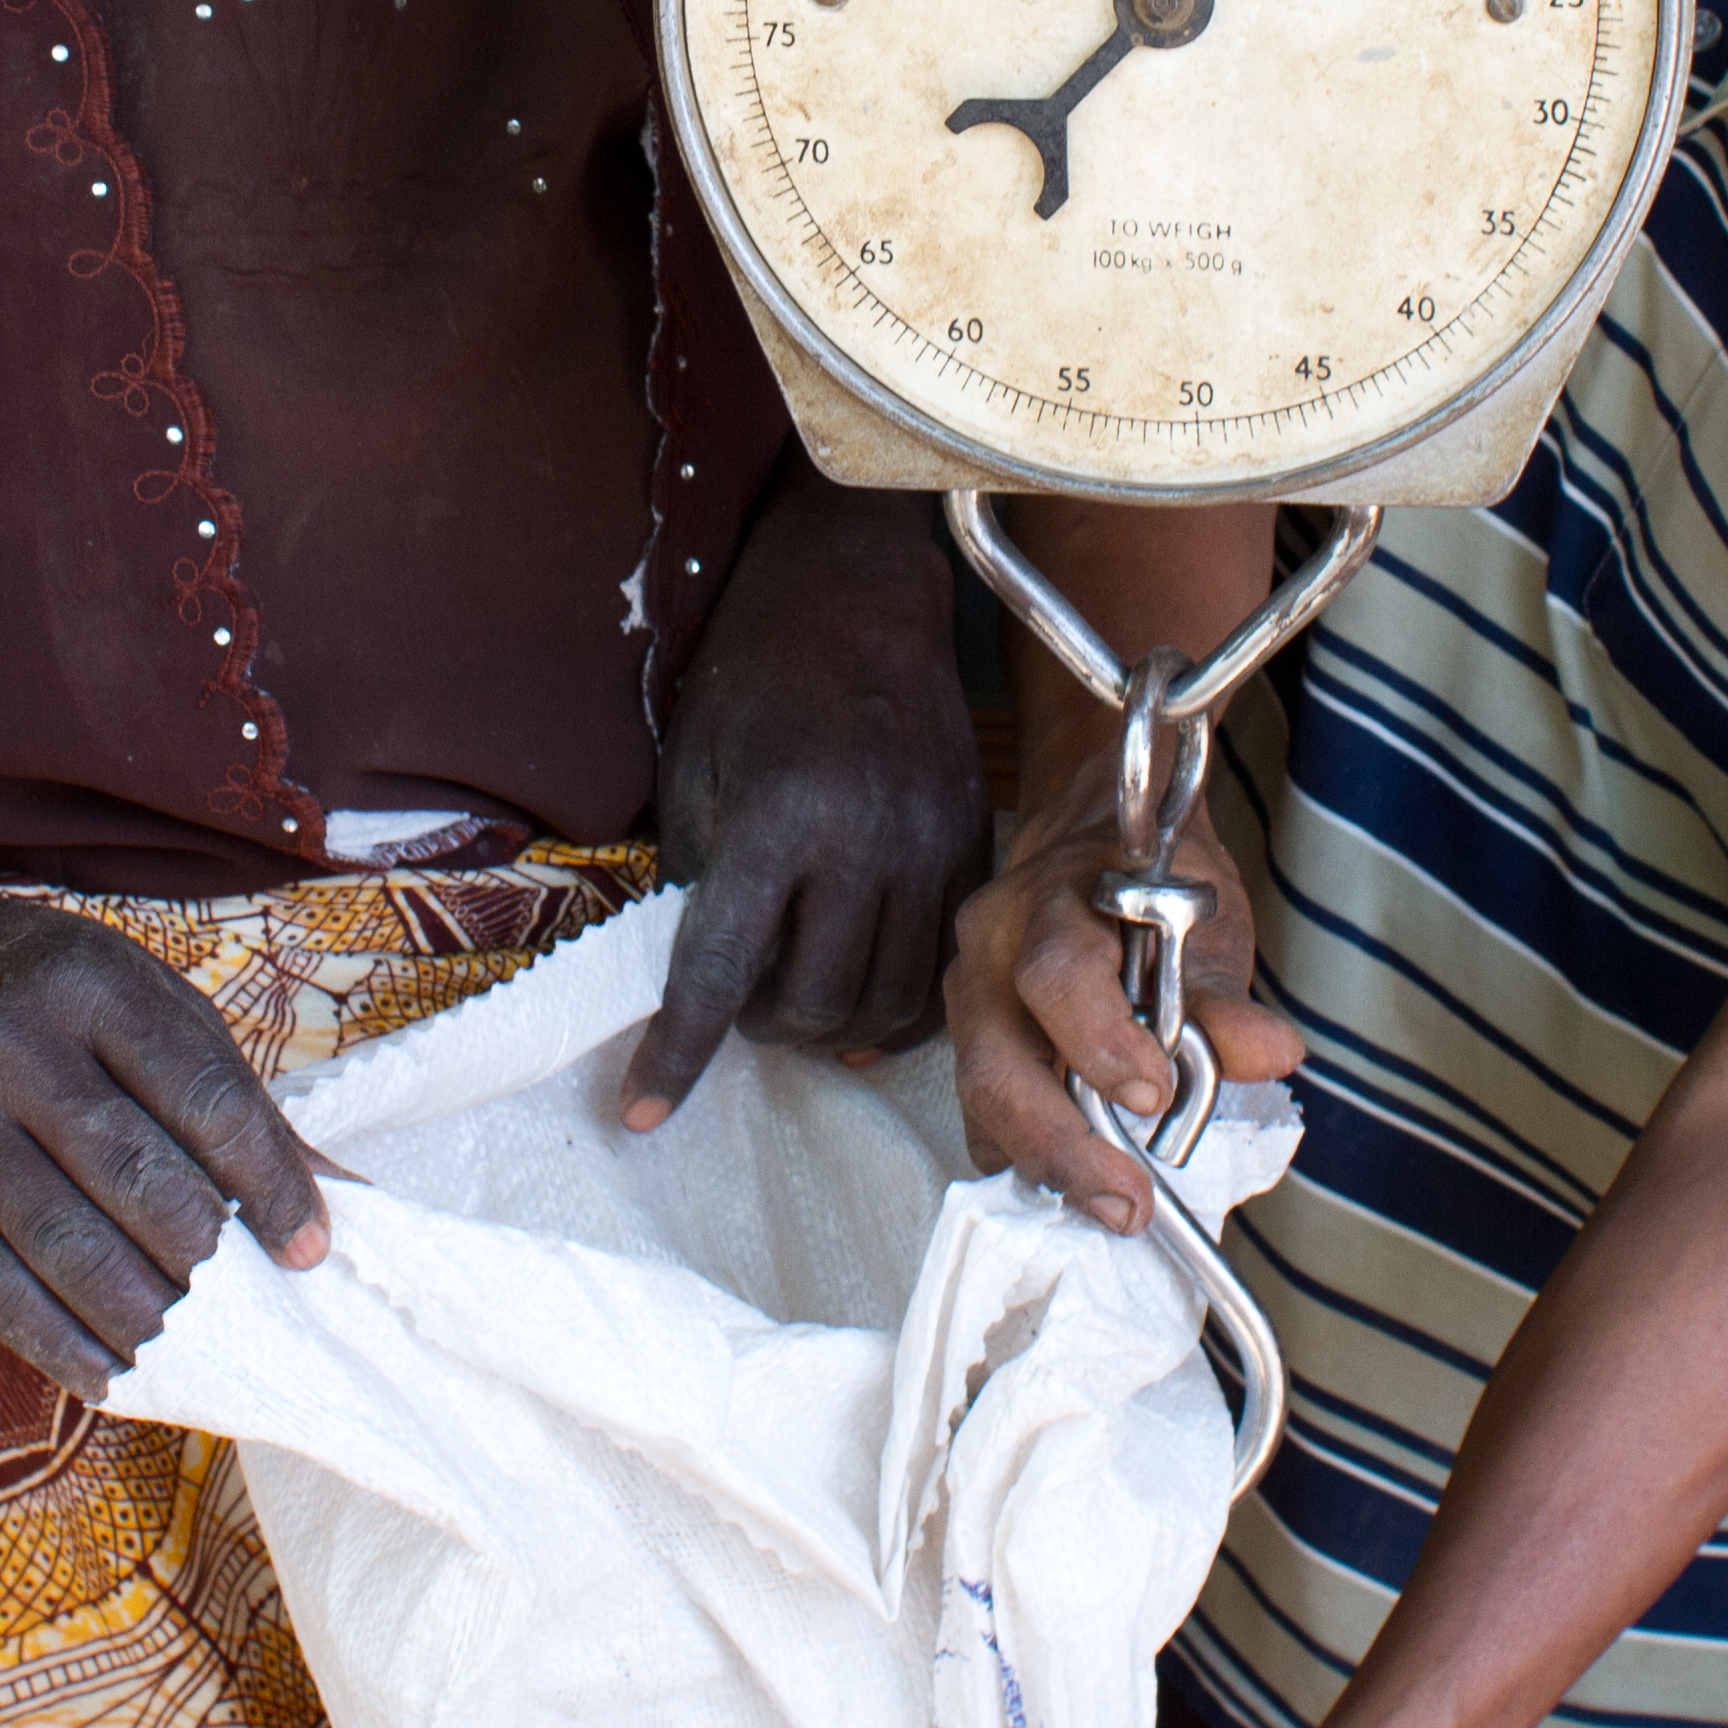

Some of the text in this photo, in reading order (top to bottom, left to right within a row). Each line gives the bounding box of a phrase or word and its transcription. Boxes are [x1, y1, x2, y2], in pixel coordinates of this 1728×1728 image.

[763, 22, 796, 48] 75
[1533, 99, 1569, 126] 30
[795, 138, 829, 165] 70
[1481, 210, 1516, 236] 35
[860, 240, 894, 265] 65
[1397, 296, 1436, 322] 40
[947, 317, 984, 344] 60
[1057, 367, 1091, 393] 55
[1294, 355, 1332, 381] 45
[1178, 381, 1214, 407] 50
